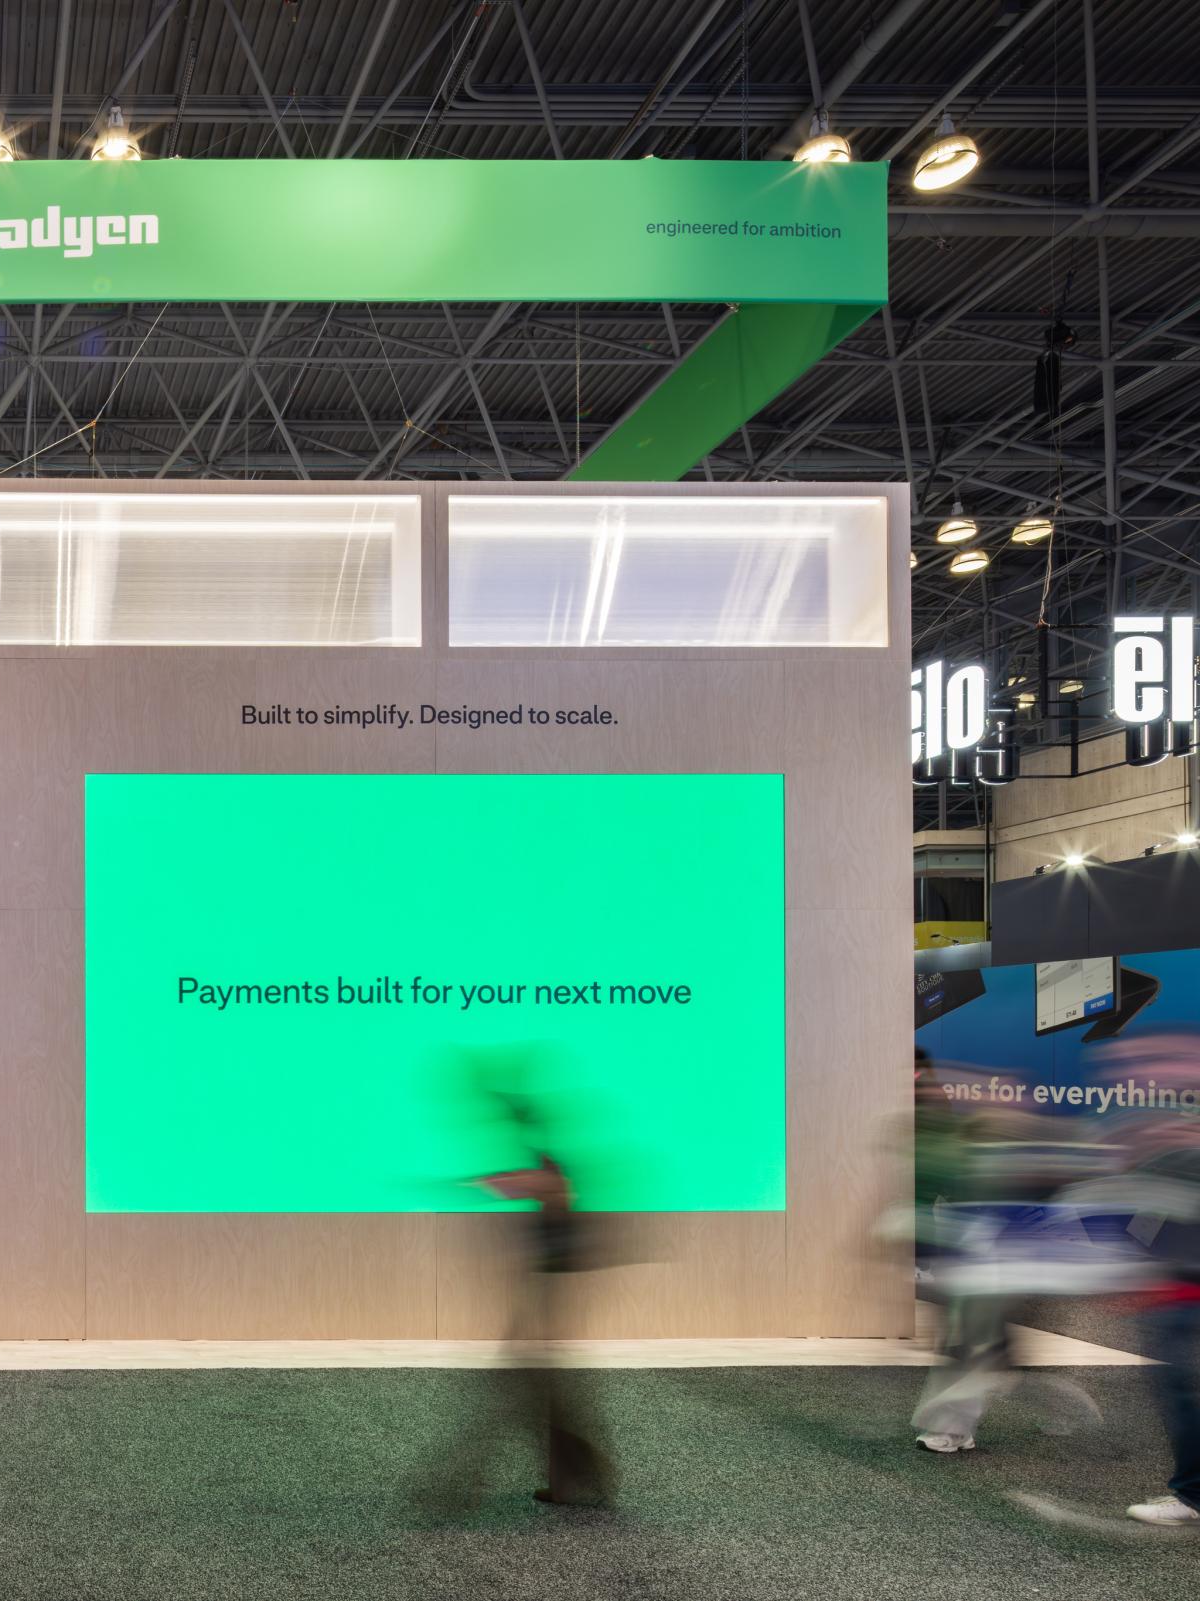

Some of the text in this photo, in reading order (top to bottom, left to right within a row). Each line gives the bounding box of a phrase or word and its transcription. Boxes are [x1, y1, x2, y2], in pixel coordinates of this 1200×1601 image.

[646, 219, 841, 239] engineered for ambition
[241, 704, 619, 729] Built to simplify. Designed to scale.
[177, 976, 692, 1011] Payments built for your next move
[988, 1076, 1026, 1102] for
